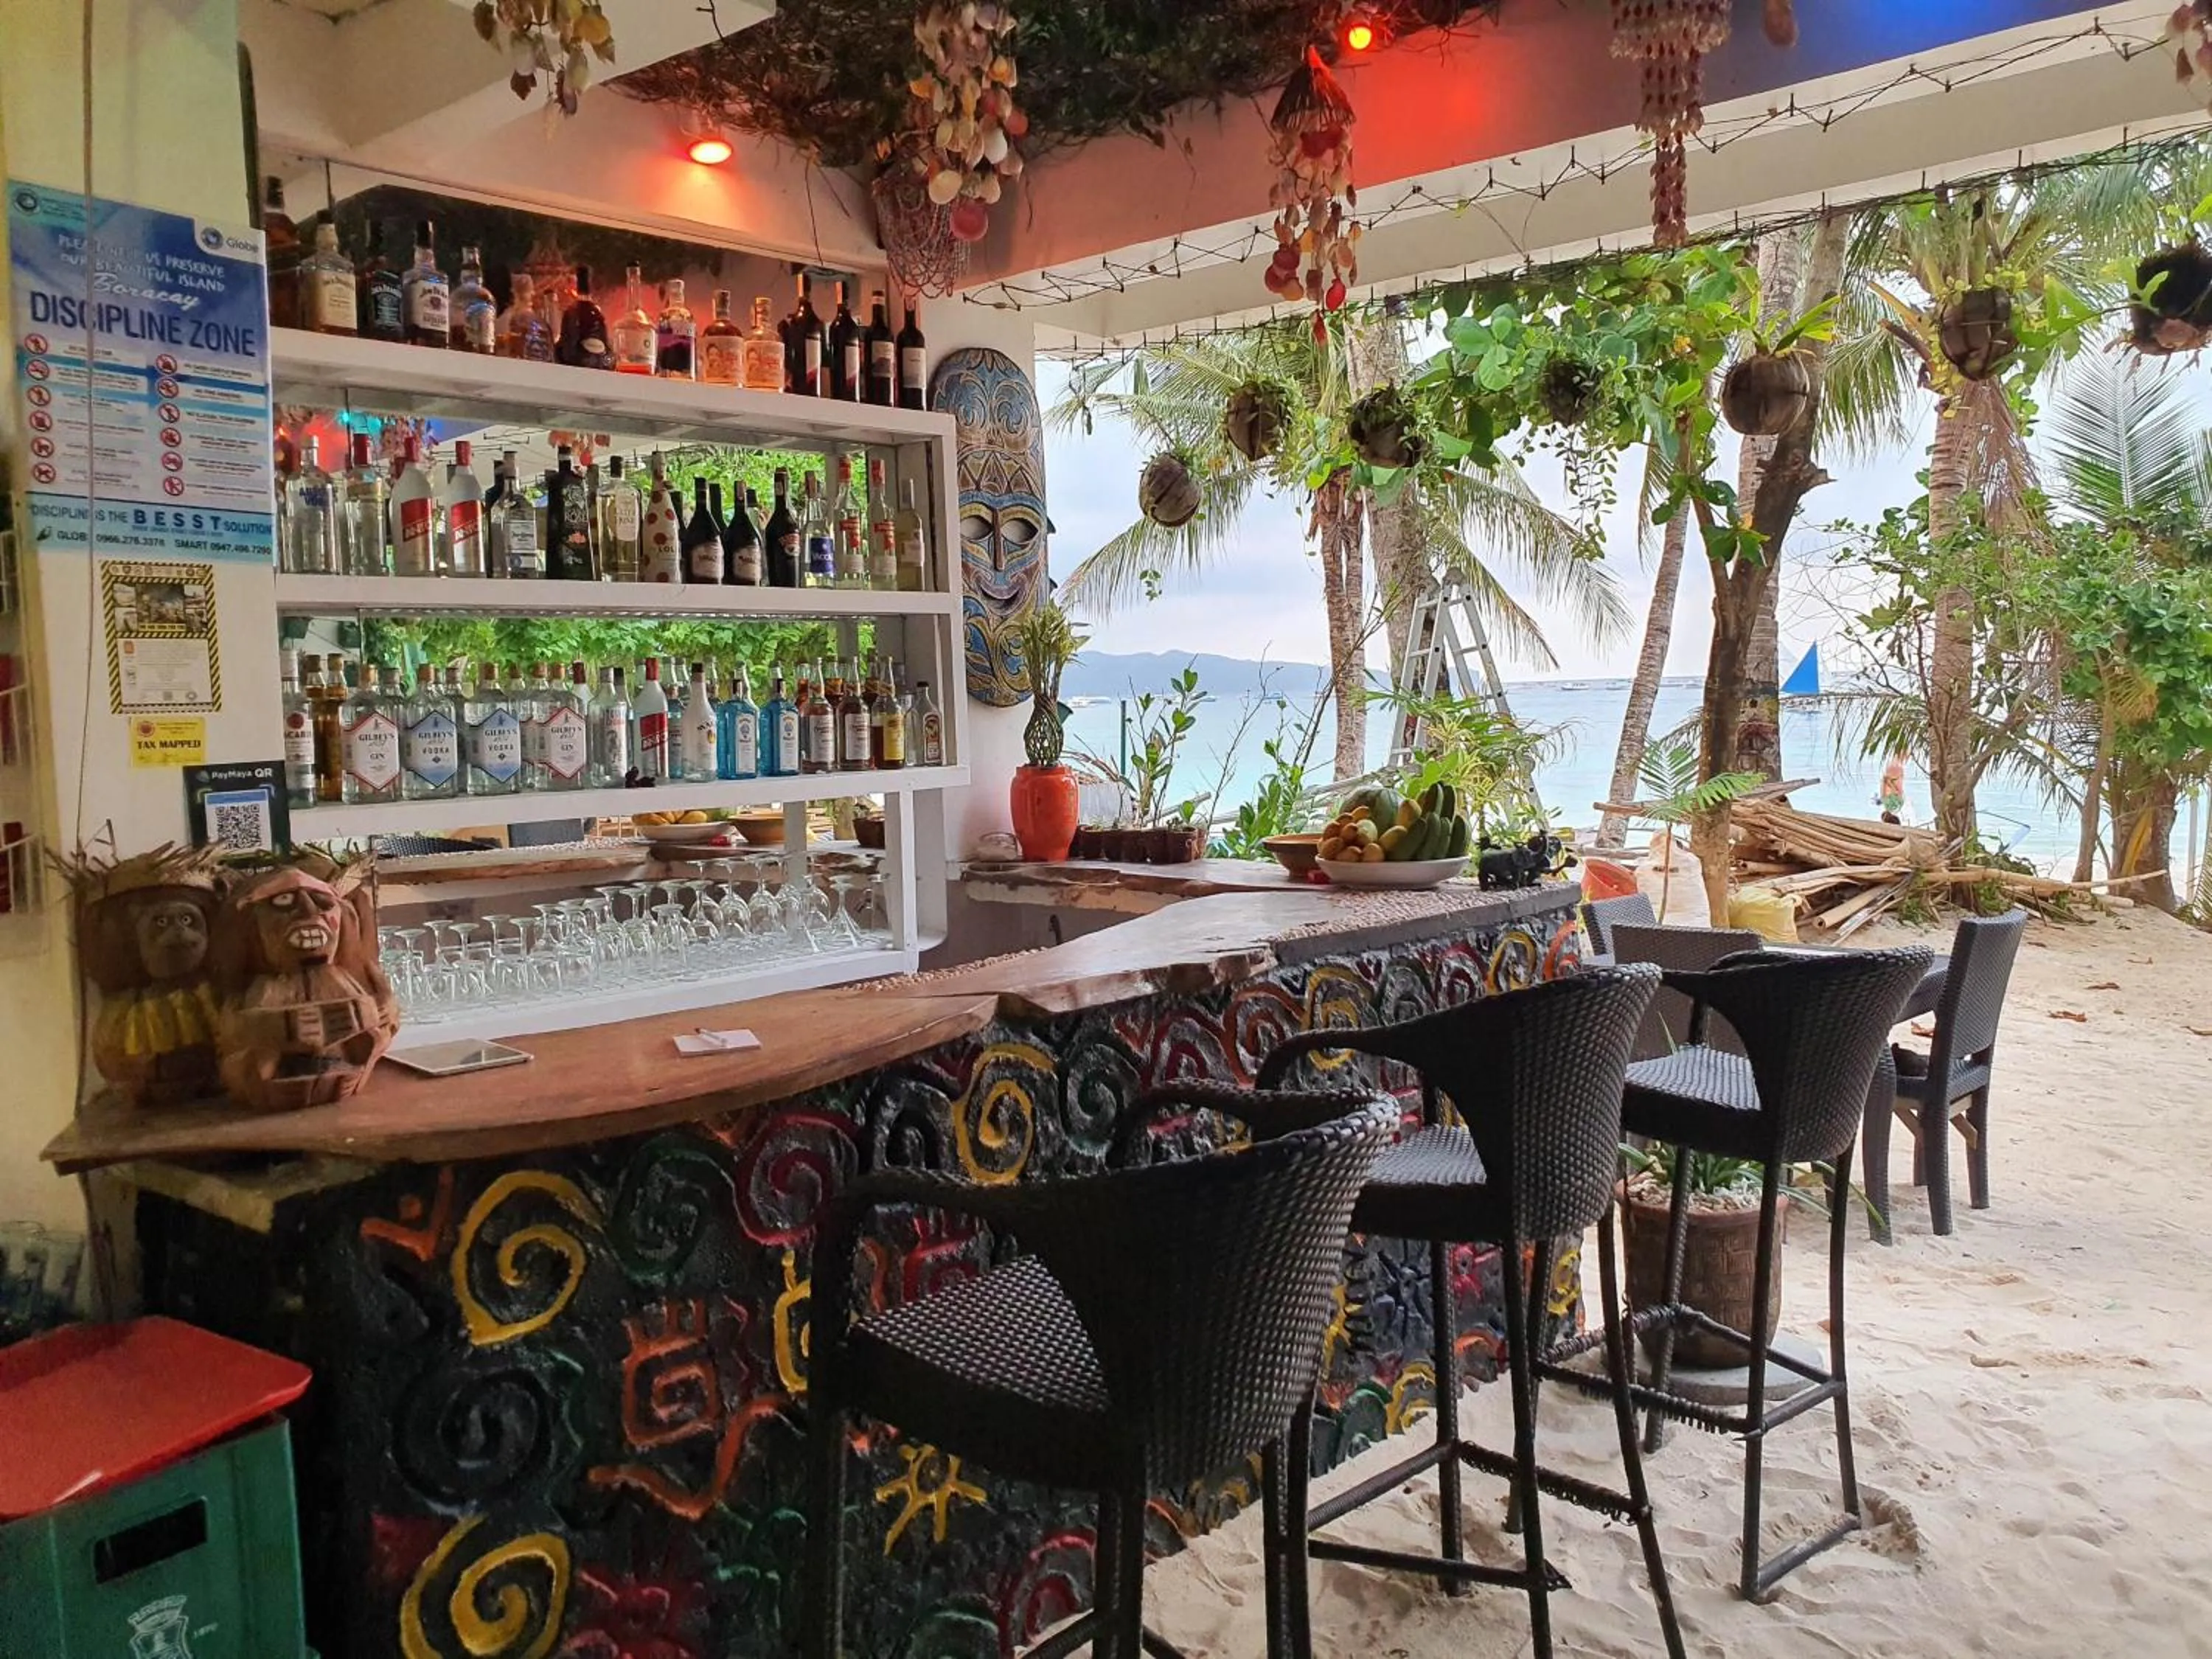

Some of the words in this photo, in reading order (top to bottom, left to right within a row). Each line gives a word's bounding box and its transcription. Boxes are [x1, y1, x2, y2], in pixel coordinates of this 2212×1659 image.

[166, 254, 225, 278] PRESERVE
[94, 271, 201, 312] Boracay
[178, 274, 225, 293] ISLAND
[189, 319, 257, 358] ZONE
[108, 509, 128, 524] THE
[175, 539, 208, 550] SMART
[137, 740, 156, 749] TAX
[159, 740, 201, 749] MAPPED
[254, 768, 272, 777] QR
